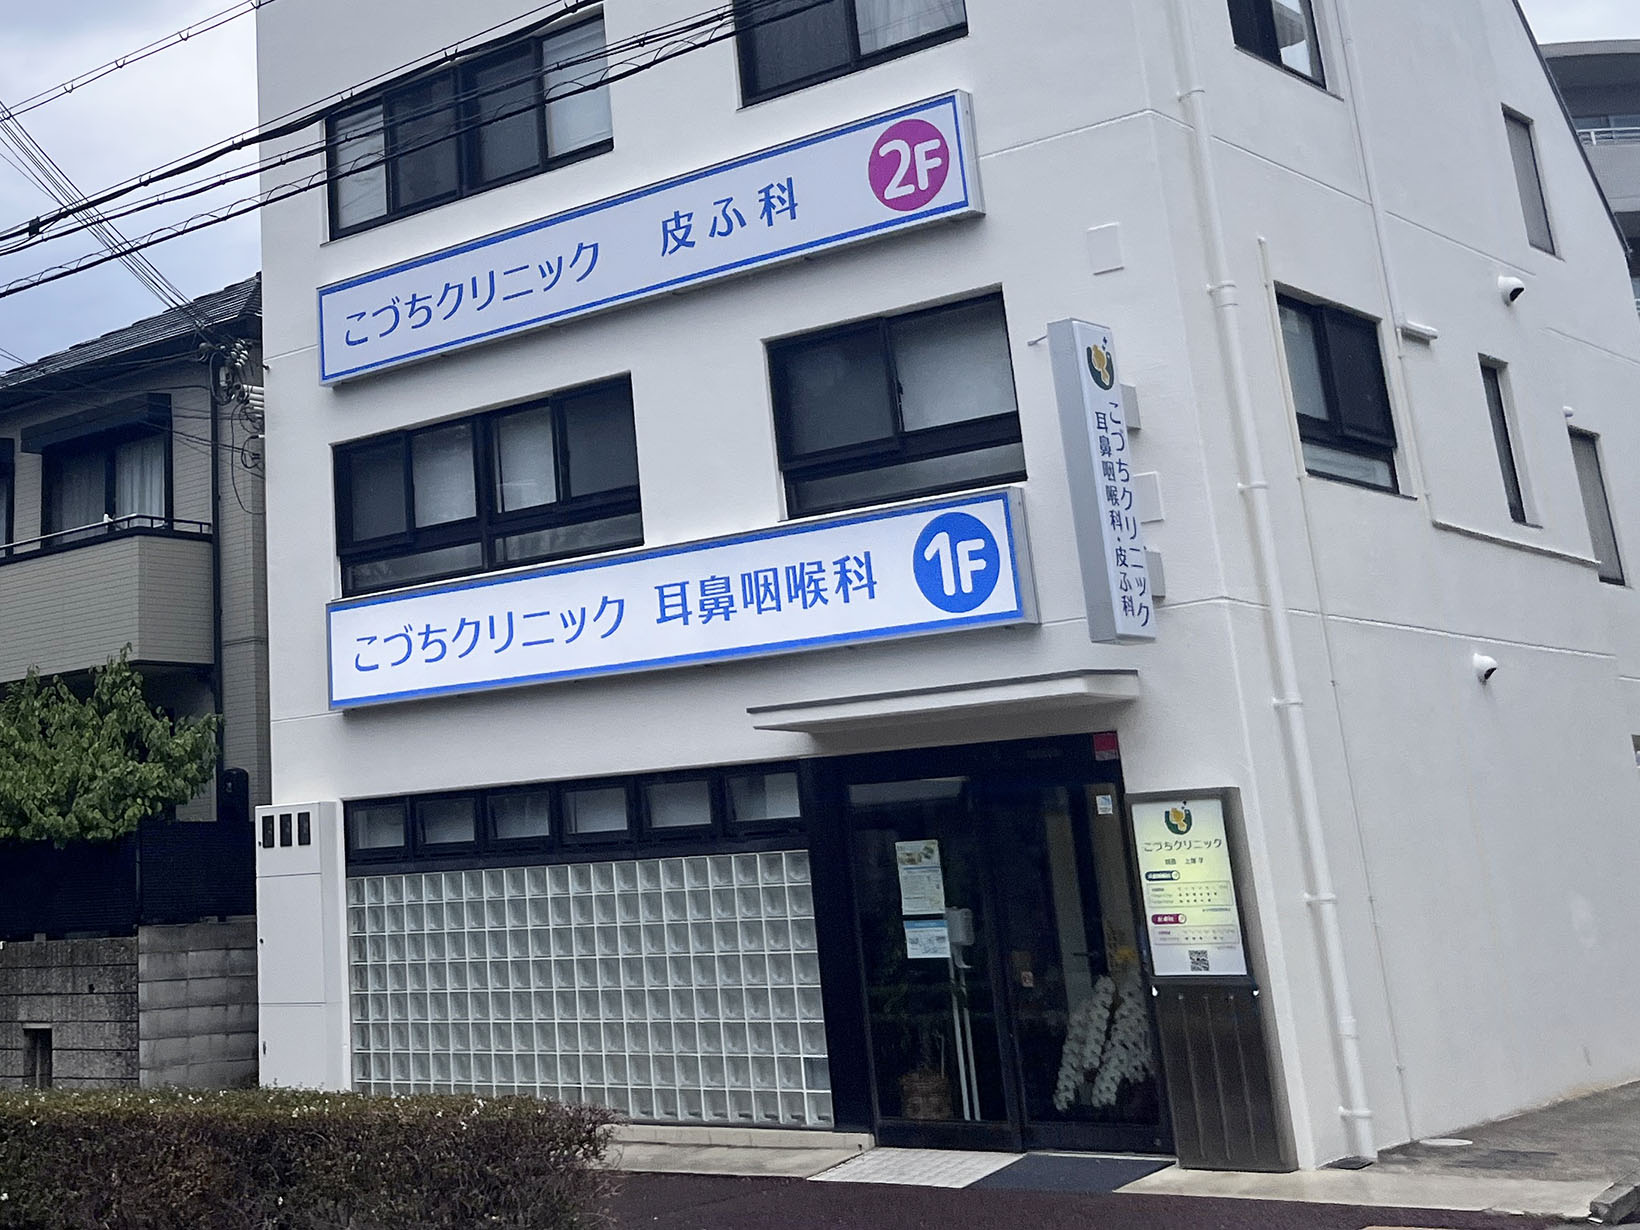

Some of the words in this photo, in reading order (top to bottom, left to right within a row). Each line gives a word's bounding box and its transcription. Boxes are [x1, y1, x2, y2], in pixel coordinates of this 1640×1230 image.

[343, 242, 600, 347] こづちクリニック
[660, 177, 799, 257] 皮ふ科
[878, 137, 943, 201] 2F
[353, 595, 626, 672] こづちクリニック
[654, 551, 878, 626] 耳鼻咽喉科
[921, 531, 988, 598] 1F
[1108, 402, 1151, 628] こづちクリニック
